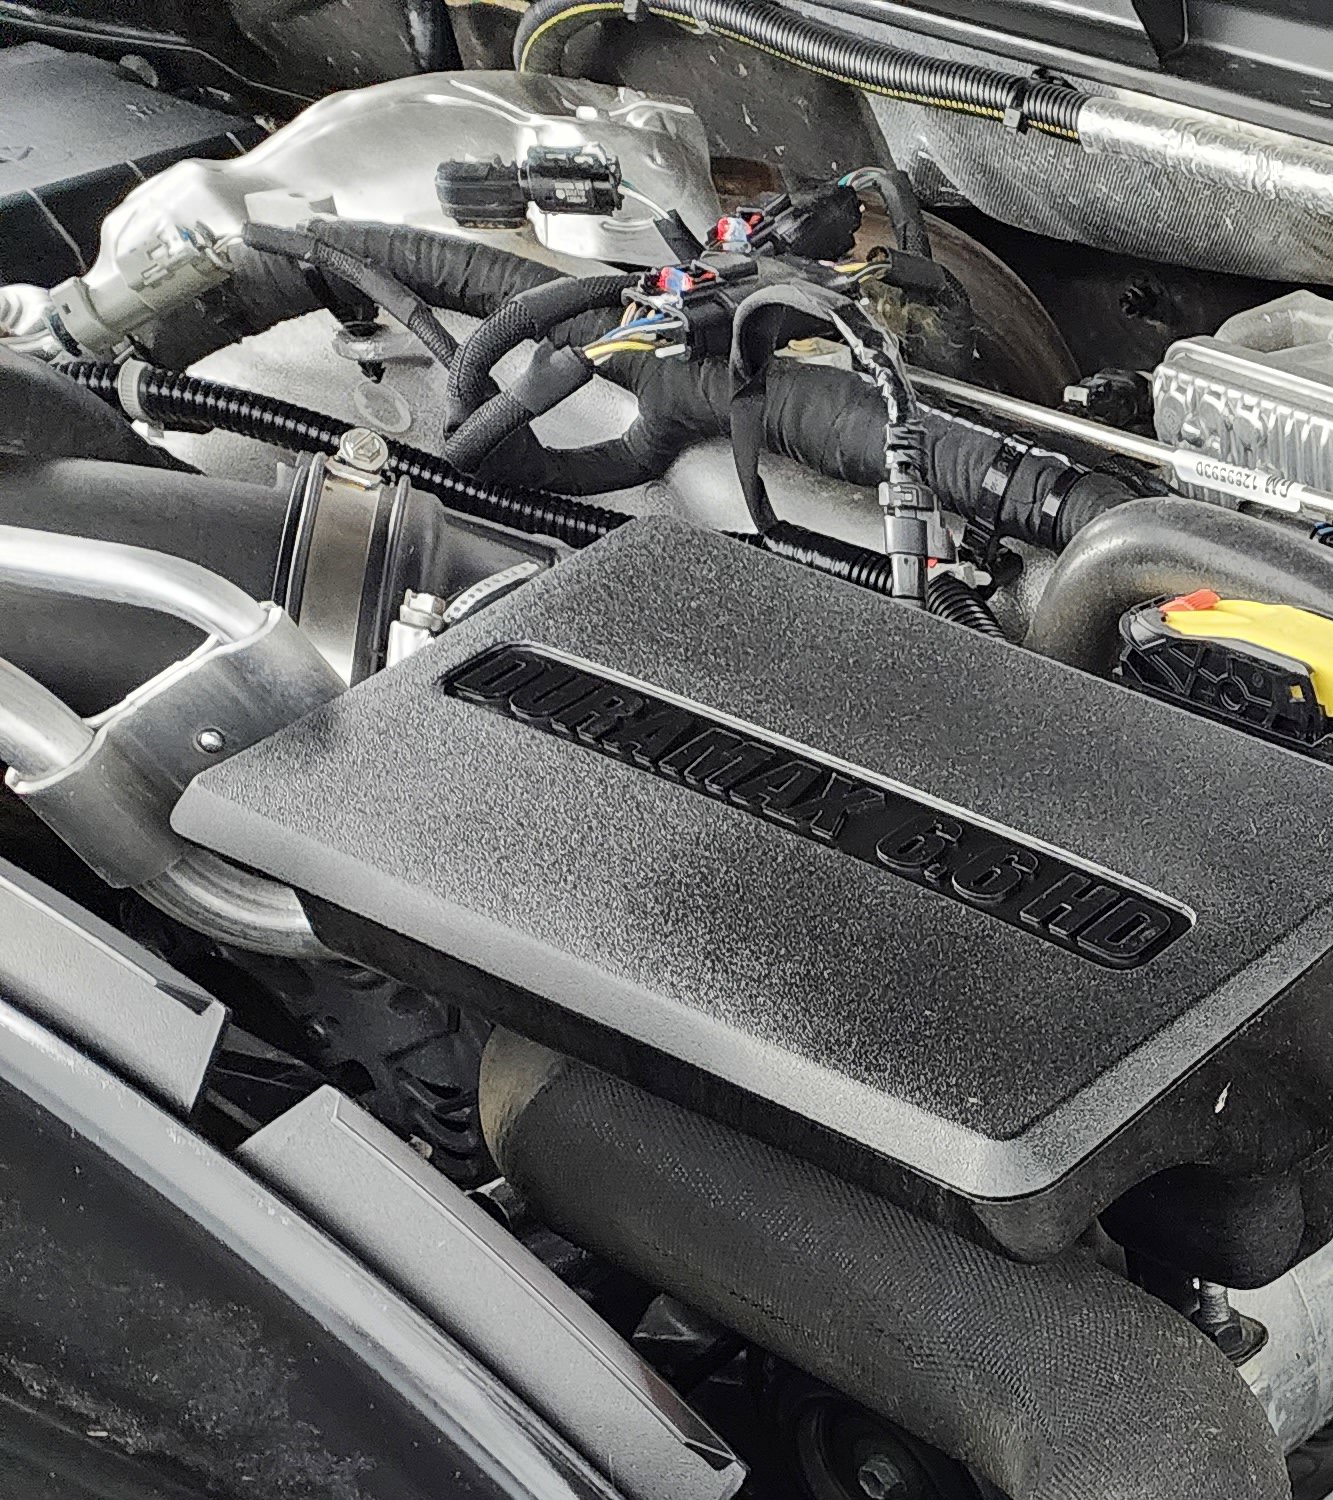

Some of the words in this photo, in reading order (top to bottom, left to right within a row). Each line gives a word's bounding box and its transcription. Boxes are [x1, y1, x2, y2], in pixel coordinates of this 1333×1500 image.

[453, 653, 887, 841] DURAMAX
[876, 816, 1039, 900] 6.6
[1020, 871, 1173, 962] HD
